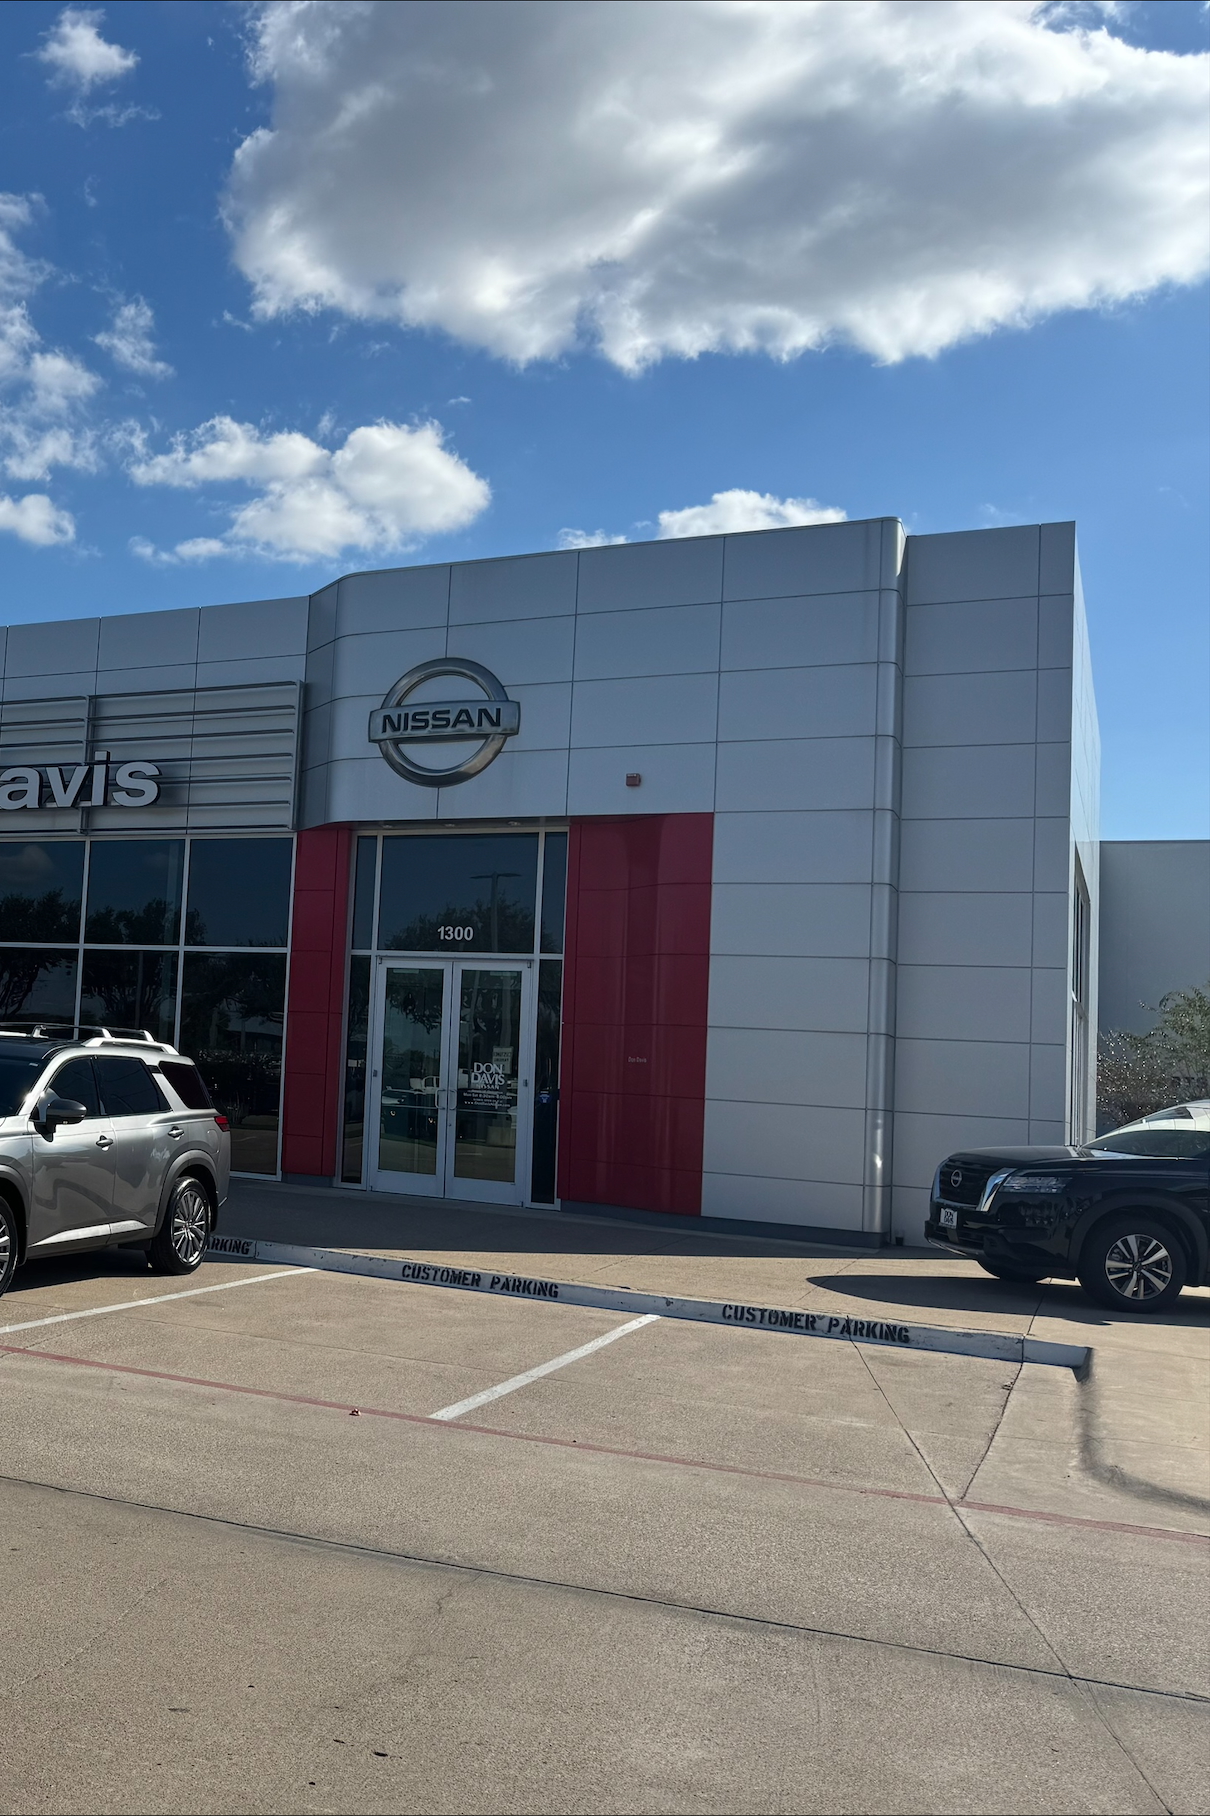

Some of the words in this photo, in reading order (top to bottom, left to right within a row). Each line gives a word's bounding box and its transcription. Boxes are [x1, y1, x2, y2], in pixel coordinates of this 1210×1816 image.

[382, 708, 501, 733] NISSAN
[437, 925, 474, 941] 1300
[474, 1062, 503, 1074] DON
[470, 1072, 505, 1085] DAVIS
[206, 1237, 251, 1254] RKING
[402, 1264, 481, 1287] CUSTOMER
[490, 1276, 559, 1298] PARKING
[722, 1304, 817, 1331] CUSTOMER
[827, 1317, 911, 1344] PARKING
